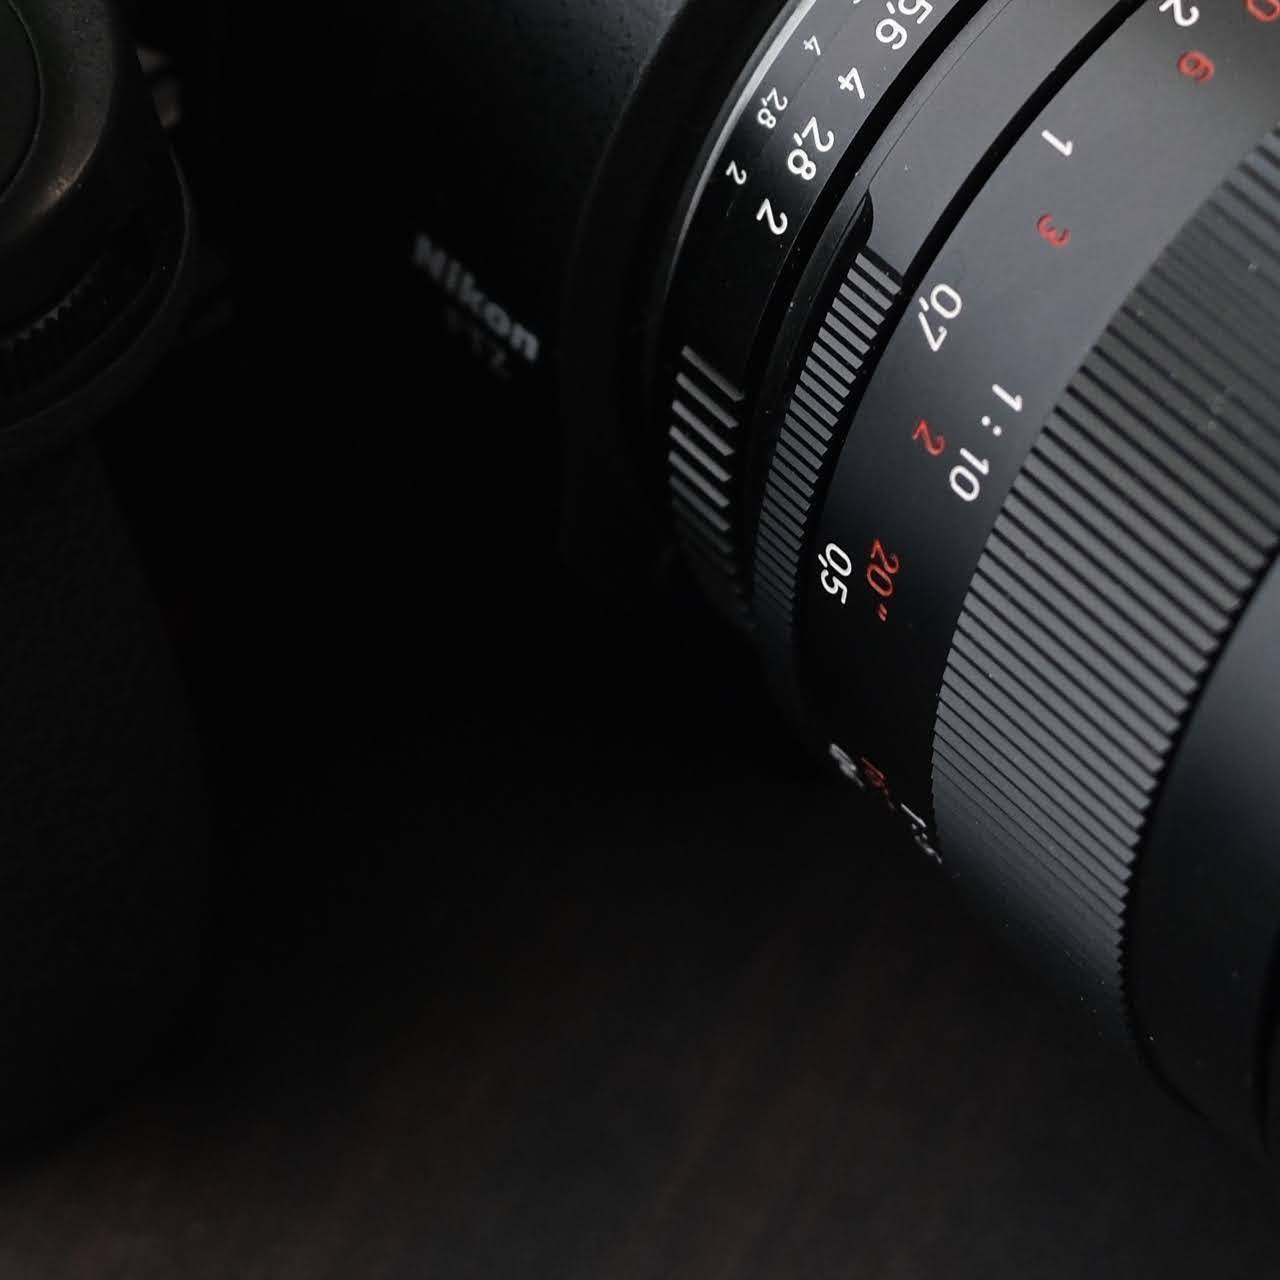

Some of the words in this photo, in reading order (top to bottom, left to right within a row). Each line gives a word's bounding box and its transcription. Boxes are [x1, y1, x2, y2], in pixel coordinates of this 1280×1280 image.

[803, 35, 821, 56] 4
[837, 67, 866, 100] 4
[1041, 129, 1073, 156] 1
[725, 160, 747, 185] 2
[756, 198, 788, 235] 2
[1034, 213, 1071, 248] 3
[913, 420, 945, 456] 2
